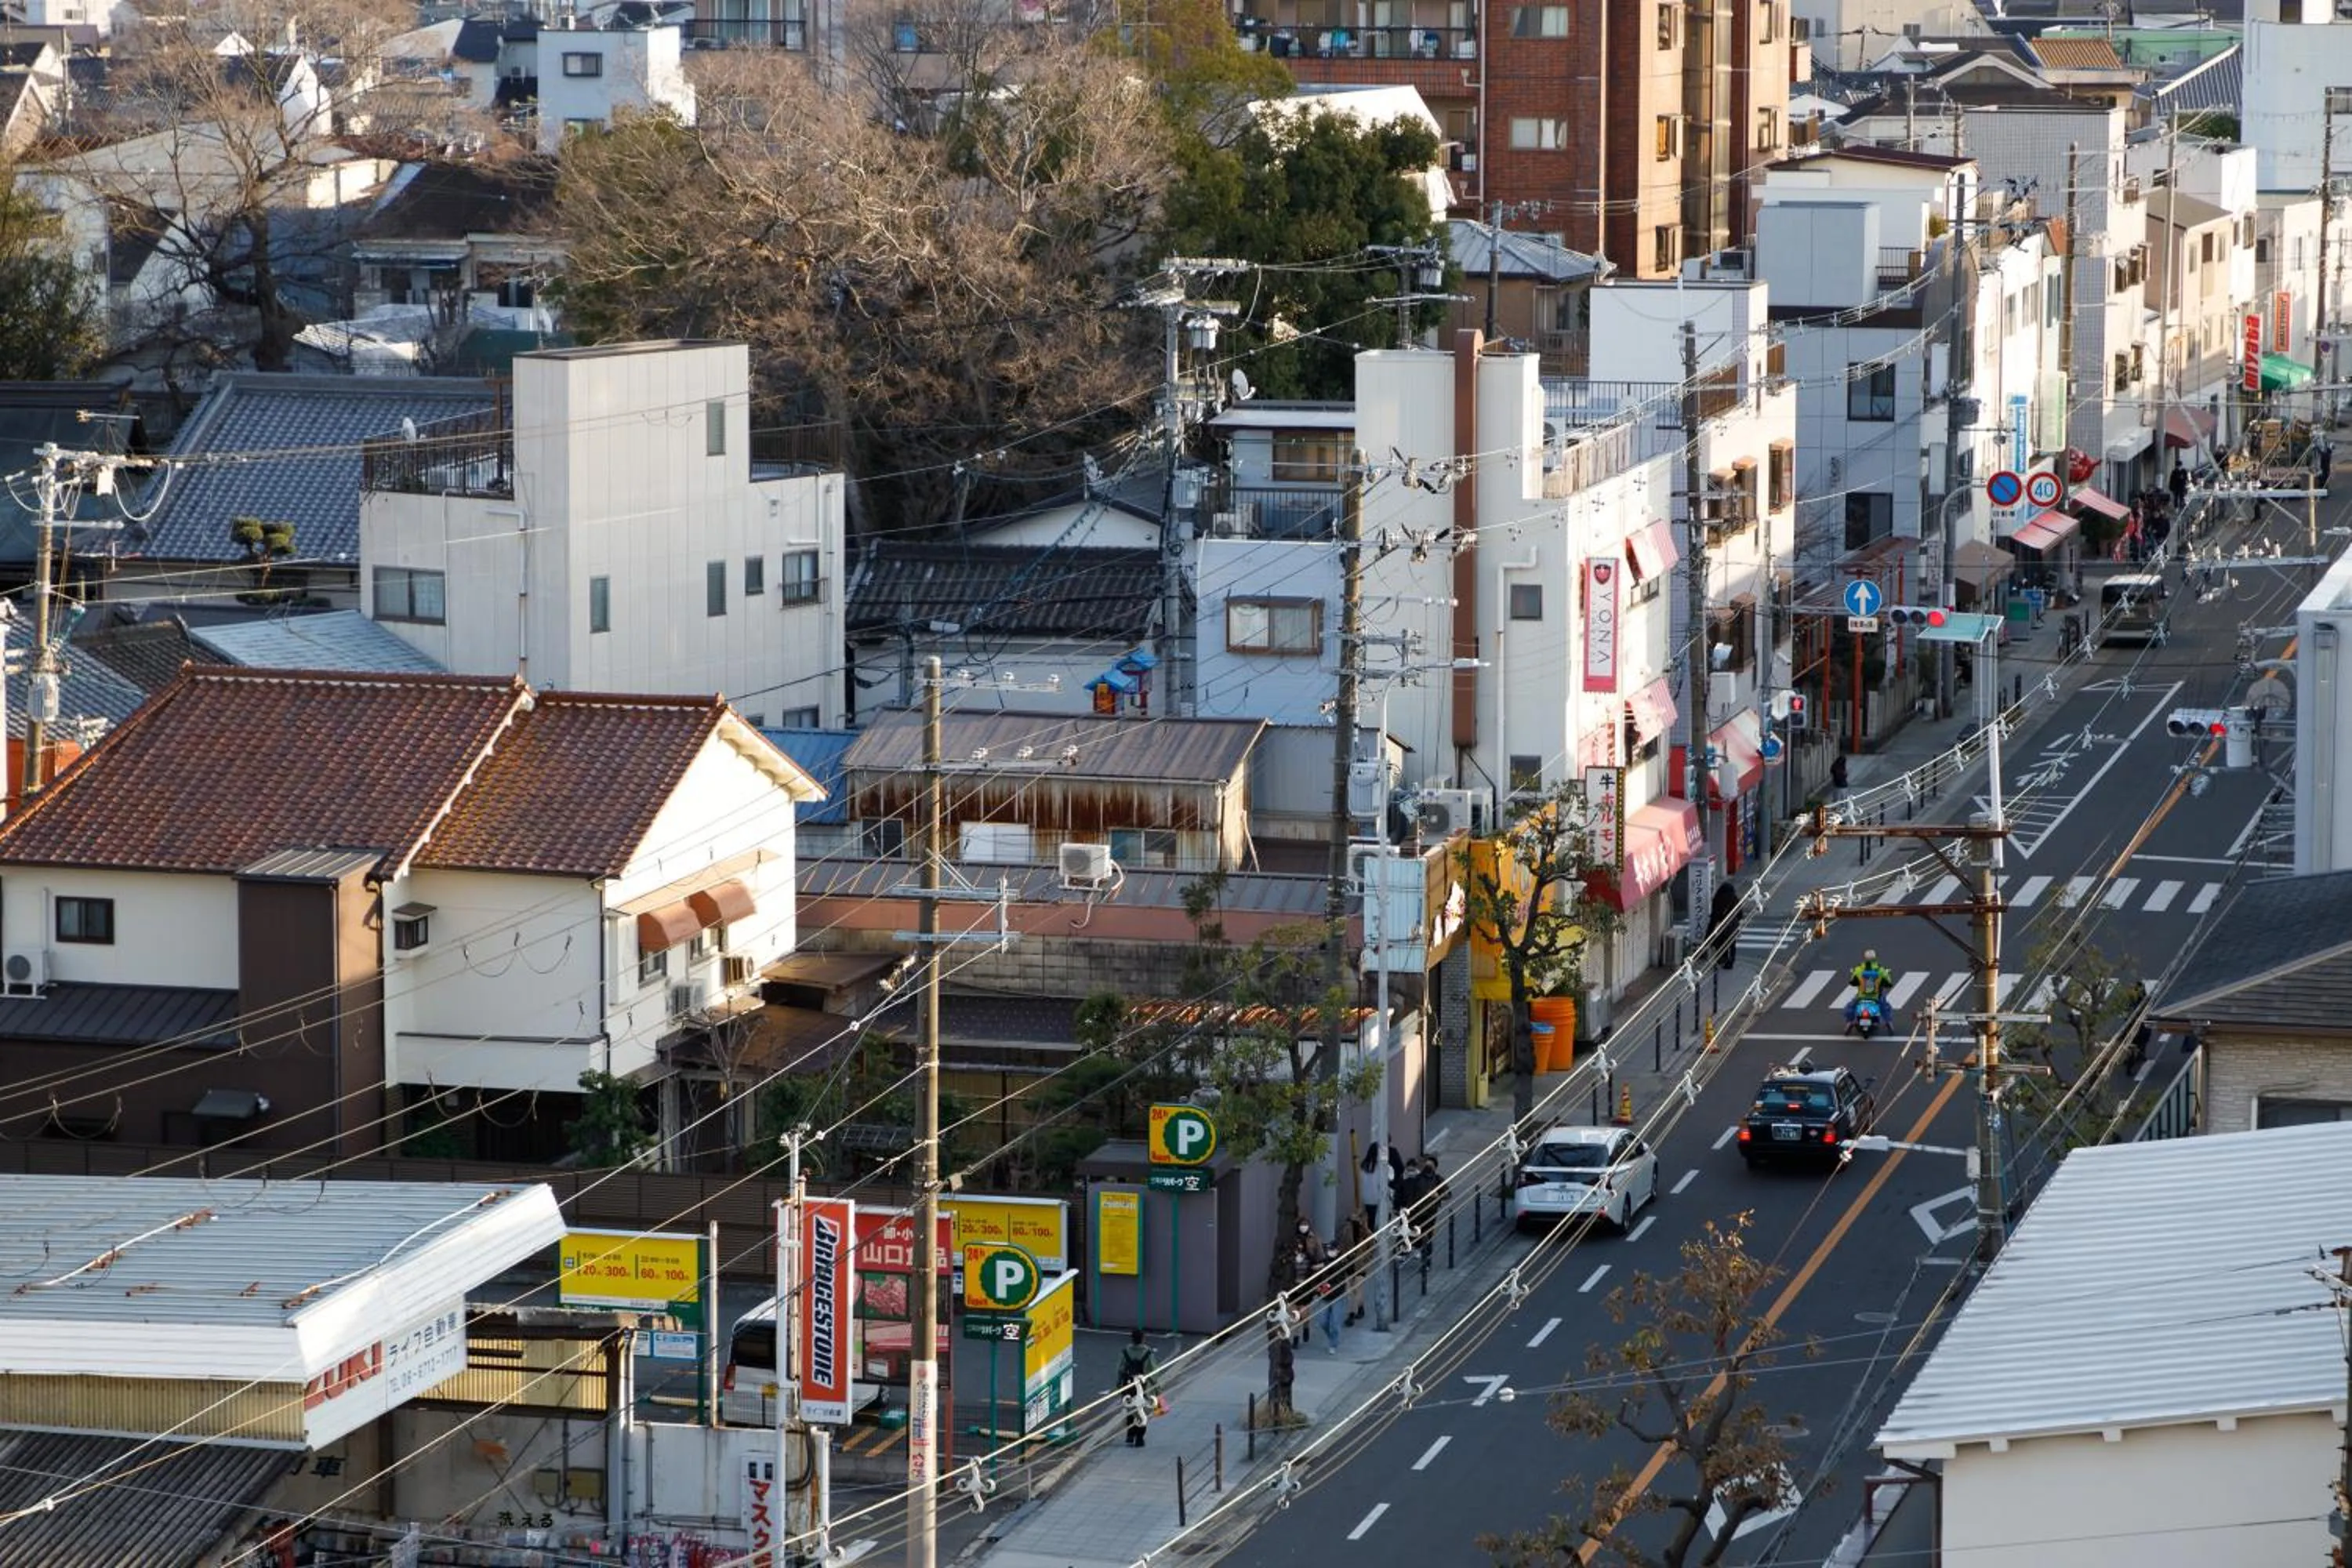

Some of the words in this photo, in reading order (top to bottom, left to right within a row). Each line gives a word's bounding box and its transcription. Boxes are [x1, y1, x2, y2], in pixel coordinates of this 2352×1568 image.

[2034, 481, 2054, 498] 40
[1599, 772, 1616, 859] 牛ホルモン
[1178, 1119, 1205, 1155] P
[1185, 1176, 1200, 1191] 空
[996, 1260, 1025, 1299] P
[813, 1214, 839, 1388] BRIDGESTONE
[1004, 1323, 1020, 1340] 空
[497, 1511, 554, 1528] 洗える
